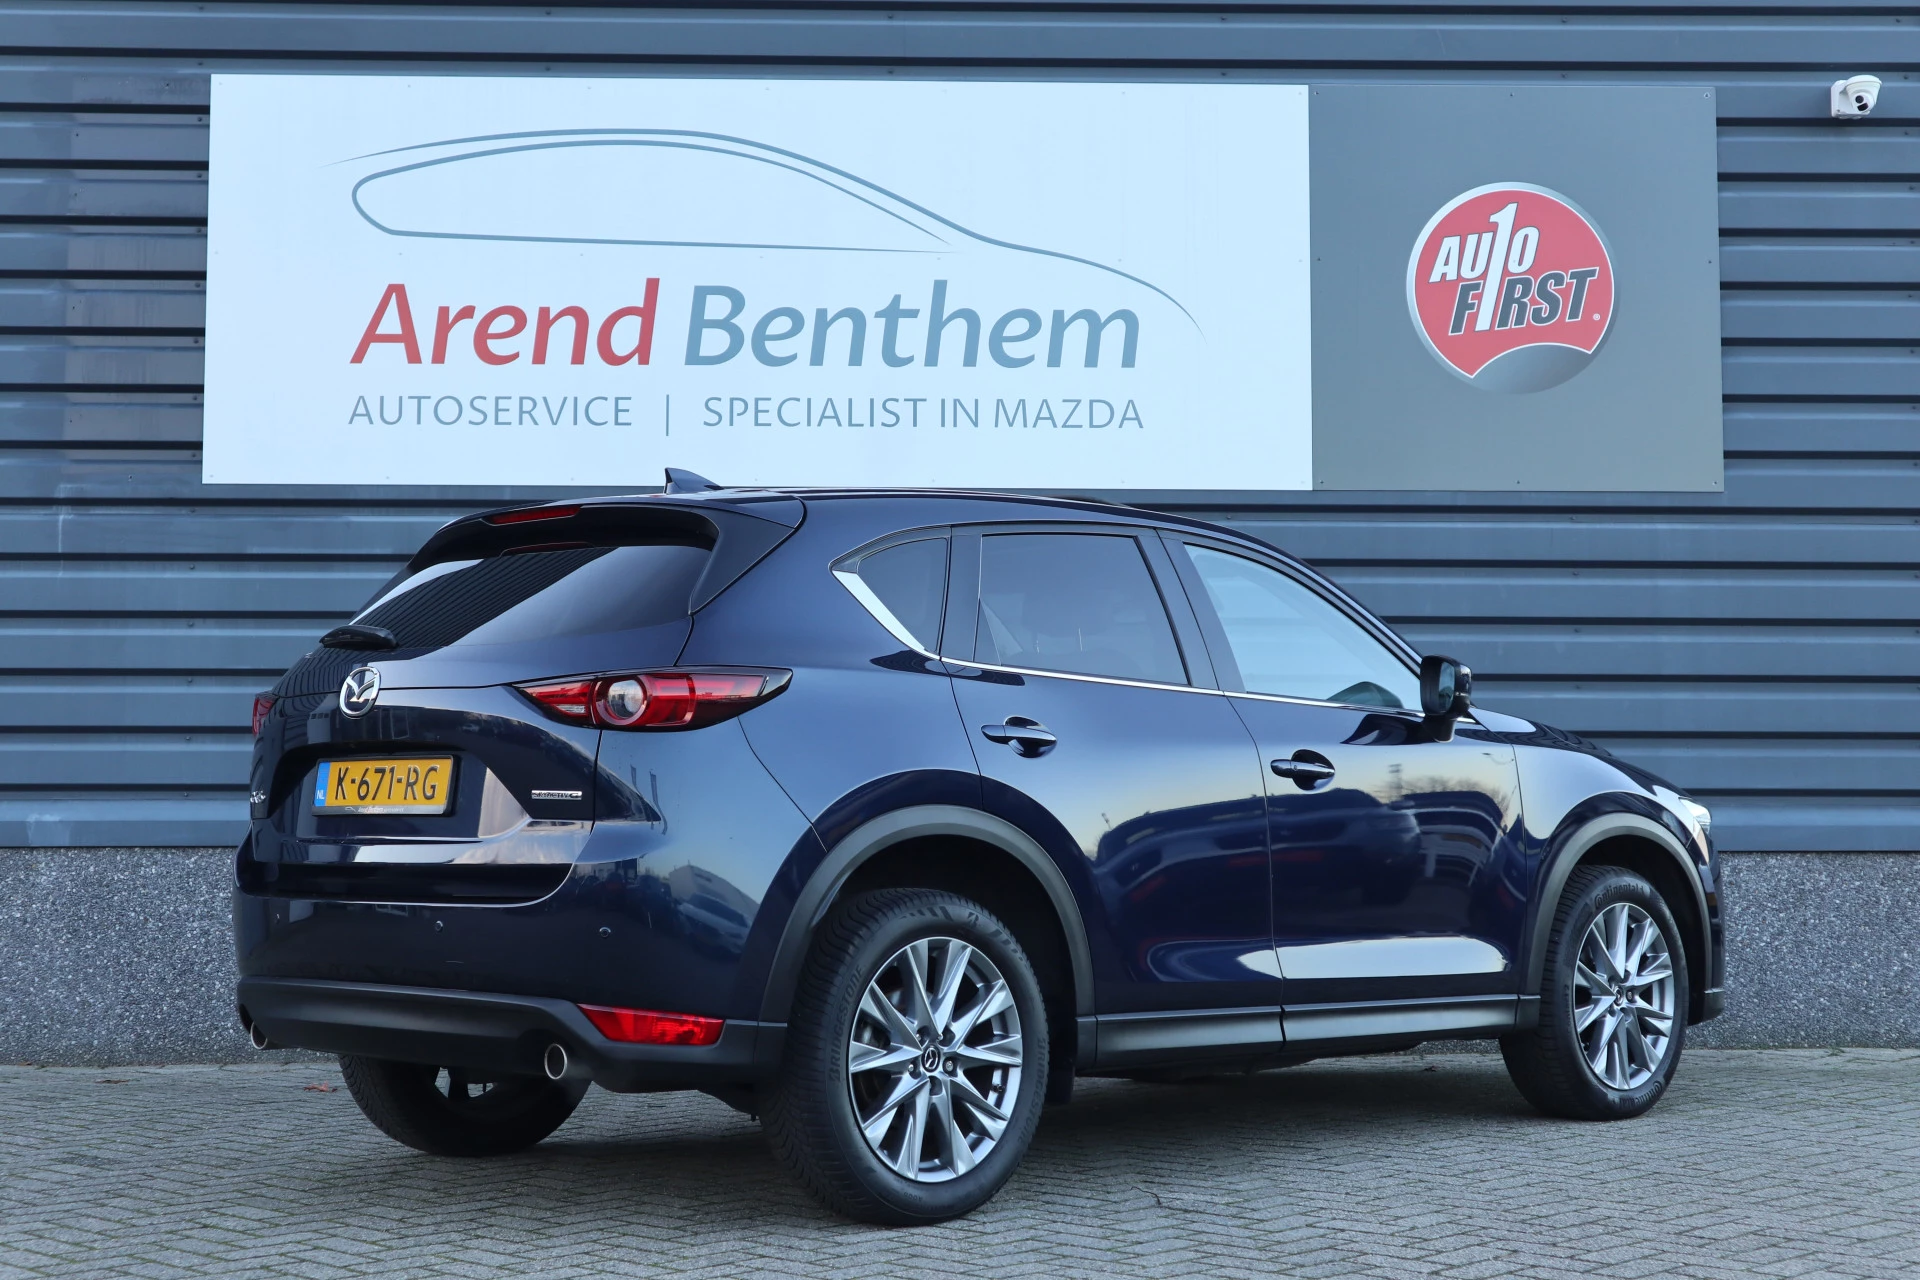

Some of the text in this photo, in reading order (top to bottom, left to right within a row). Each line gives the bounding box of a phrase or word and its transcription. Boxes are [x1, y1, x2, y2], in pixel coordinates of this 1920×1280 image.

[350, 278, 1140, 368] Arend Benthem
[348, 396, 1143, 428] AUTOSERVICE SPECIALIST IN MAZDA
[316, 789, 325, 800] NL
[334, 765, 440, 801] K-671-RG
[828, 964, 863, 1082] BRIDGESTONE
